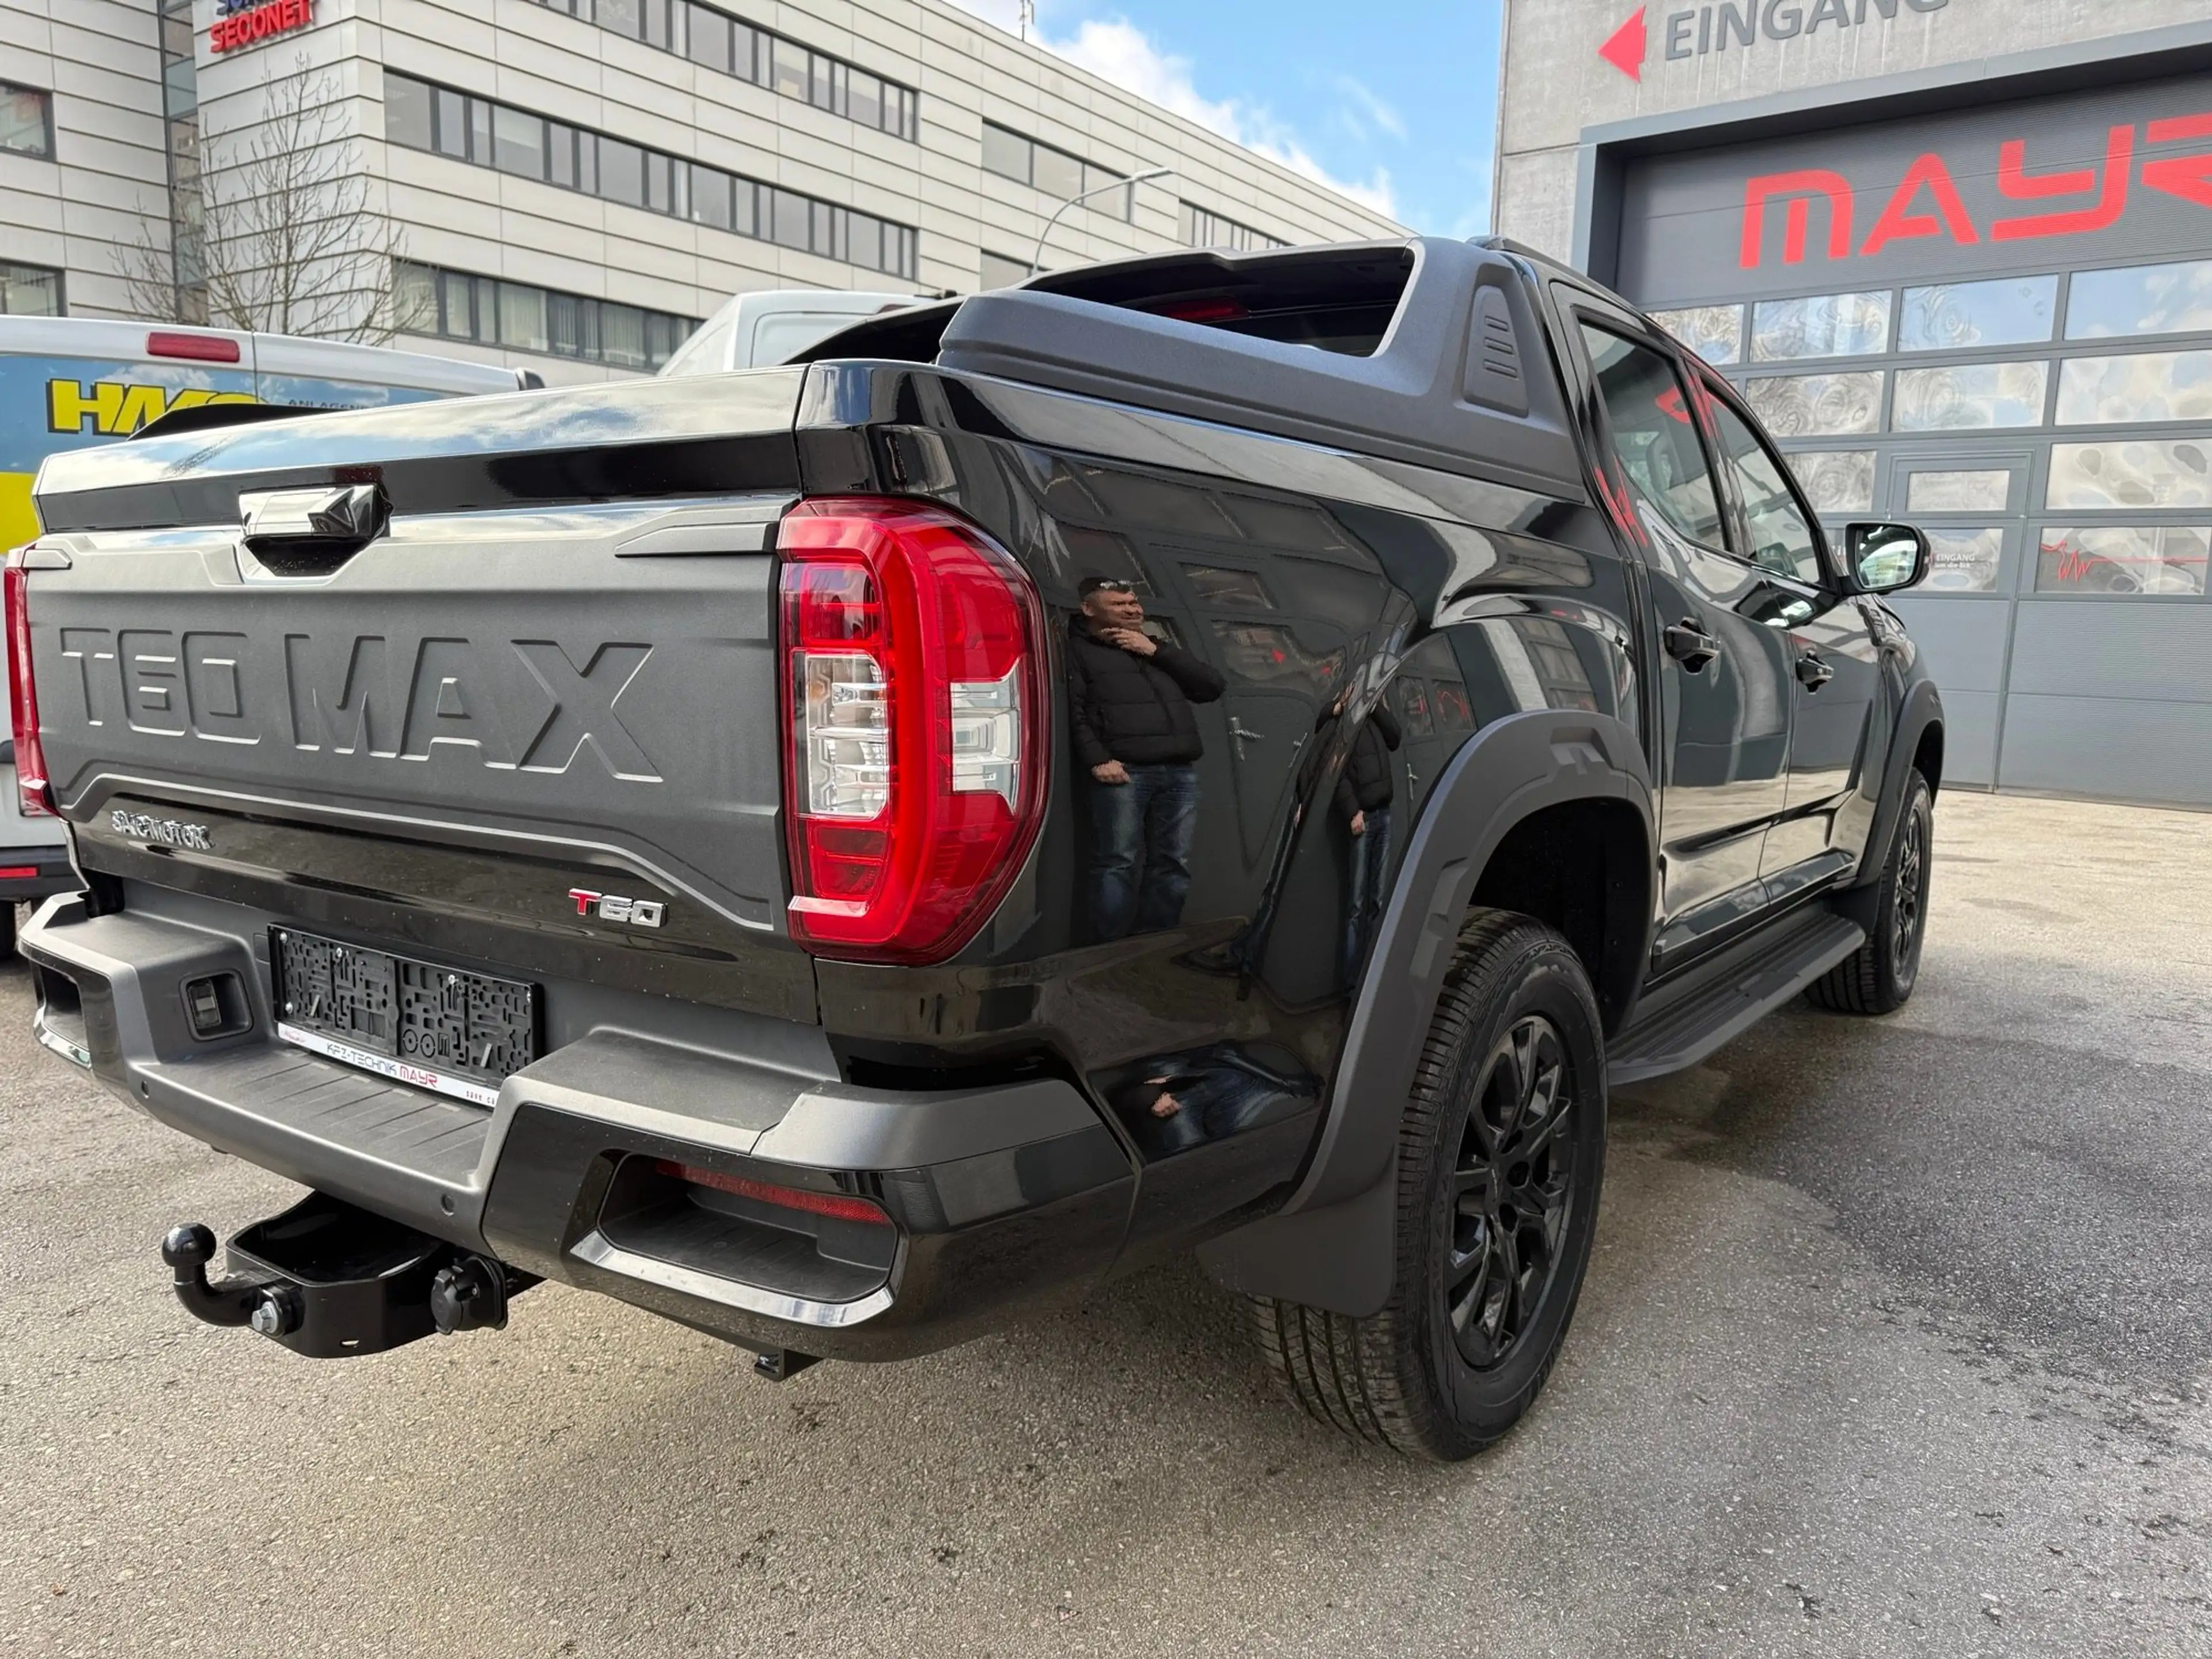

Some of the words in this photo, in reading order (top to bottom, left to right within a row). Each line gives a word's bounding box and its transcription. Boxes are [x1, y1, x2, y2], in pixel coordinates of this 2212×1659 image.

[1665, 0, 1949, 61] EINGAN
[1936, 553, 1975, 562] EINGANG
[284, 634, 664, 783] MAX
[568, 888, 666, 928] T60
[327, 1043, 397, 1075] KFZ-TECHNIK
[400, 1065, 438, 1088] MAYR
